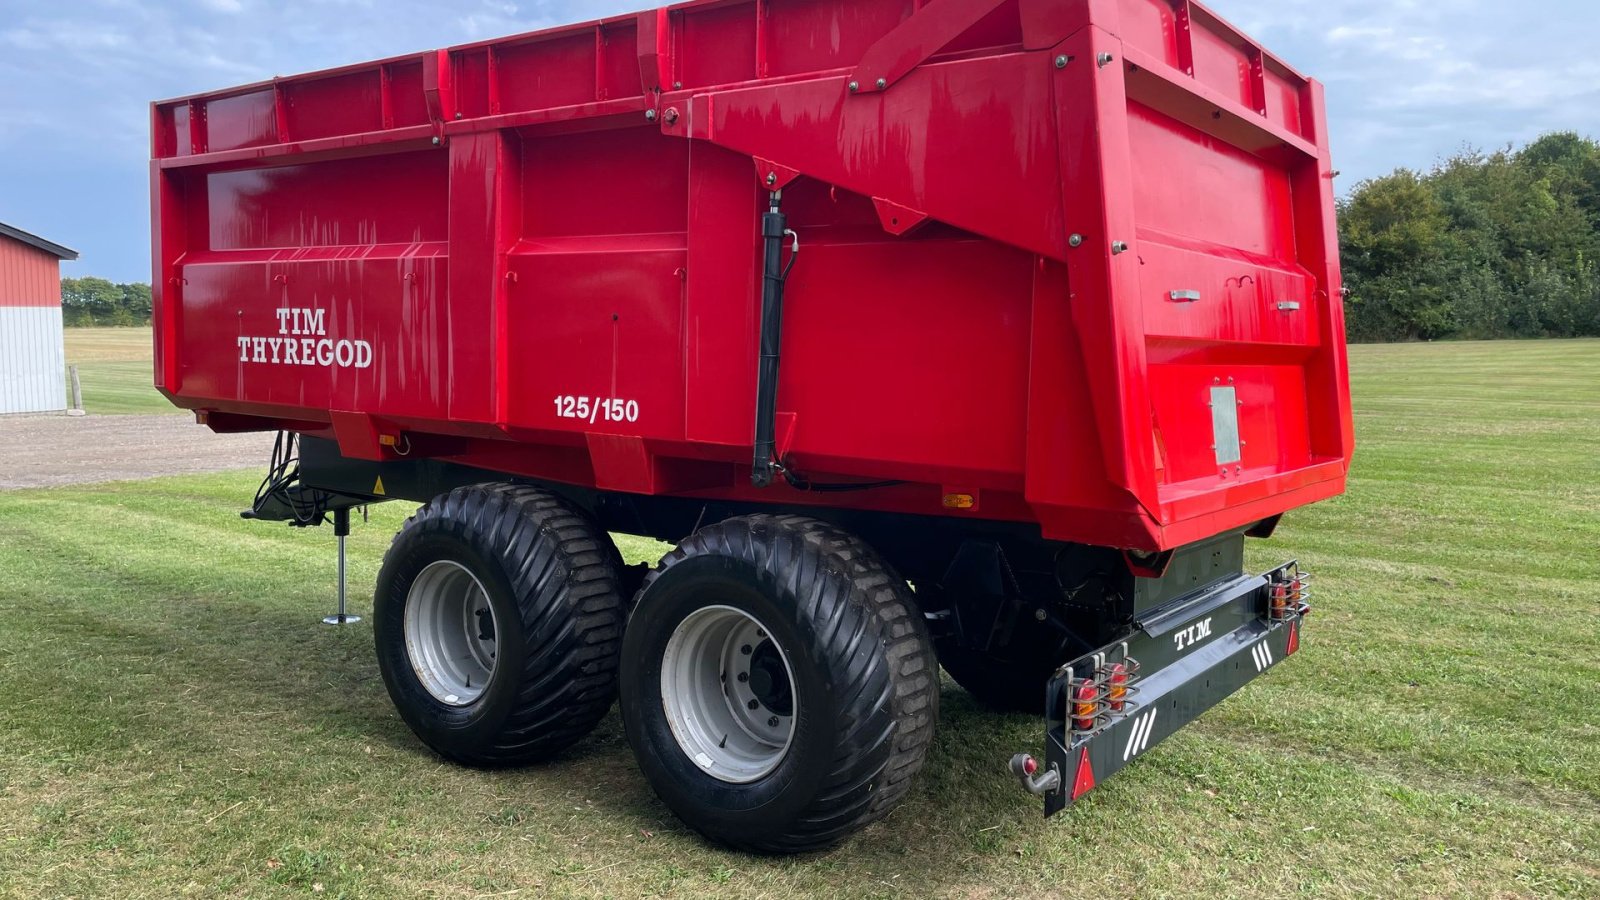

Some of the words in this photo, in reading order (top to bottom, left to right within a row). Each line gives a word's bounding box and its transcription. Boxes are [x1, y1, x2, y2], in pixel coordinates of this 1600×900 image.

[276, 308, 326, 335] TIM
[237, 336, 372, 368] THYREGOD
[554, 395, 639, 424] 125/150
[1174, 617, 1212, 651] TIM
